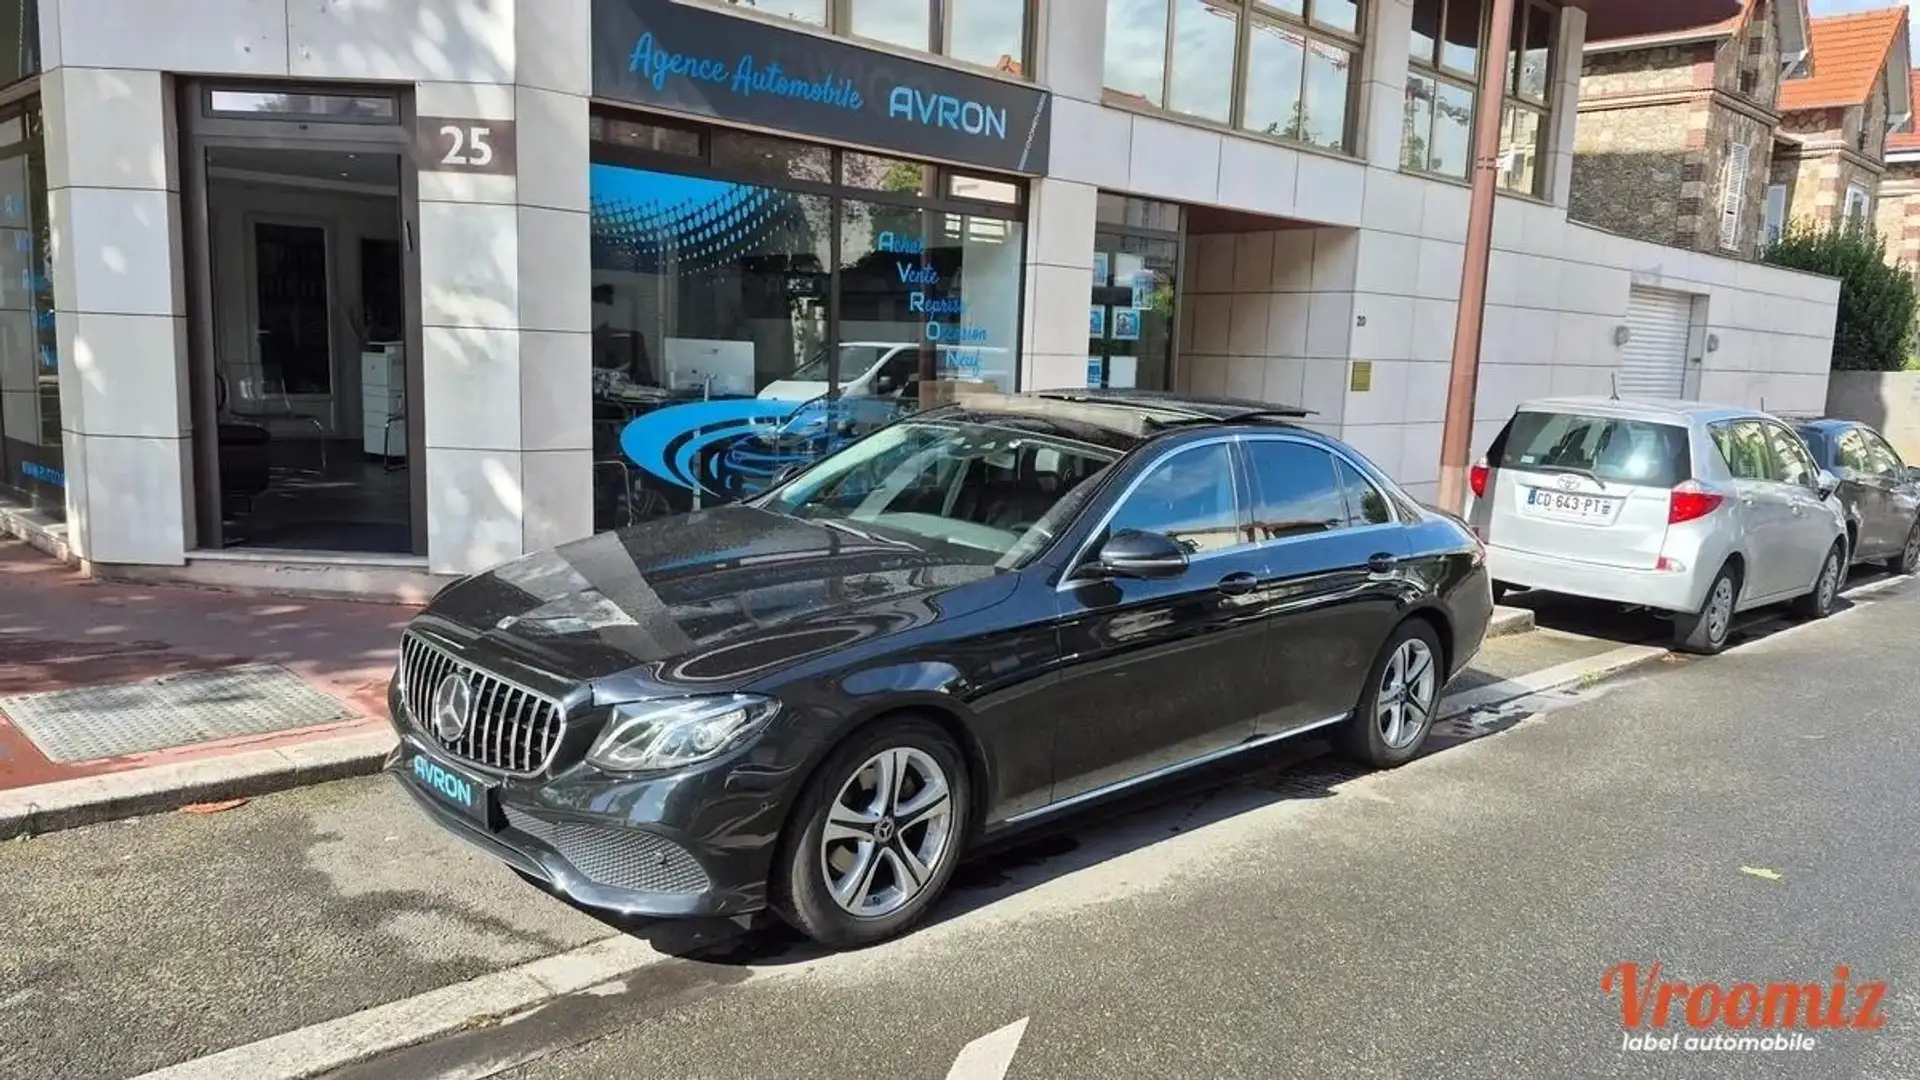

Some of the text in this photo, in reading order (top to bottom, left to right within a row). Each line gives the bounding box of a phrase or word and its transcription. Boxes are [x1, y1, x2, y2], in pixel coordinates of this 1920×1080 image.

[629, 32, 729, 91] Agence
[731, 54, 863, 110] Automobile
[889, 86, 1007, 140] AVRON
[440, 125, 493, 165] 25
[878, 230, 926, 255] Achat
[896, 261, 941, 285] Vente
[910, 291, 970, 321] Reprise
[945, 348, 982, 375] Neuf
[413, 755, 471, 807] AVRON
